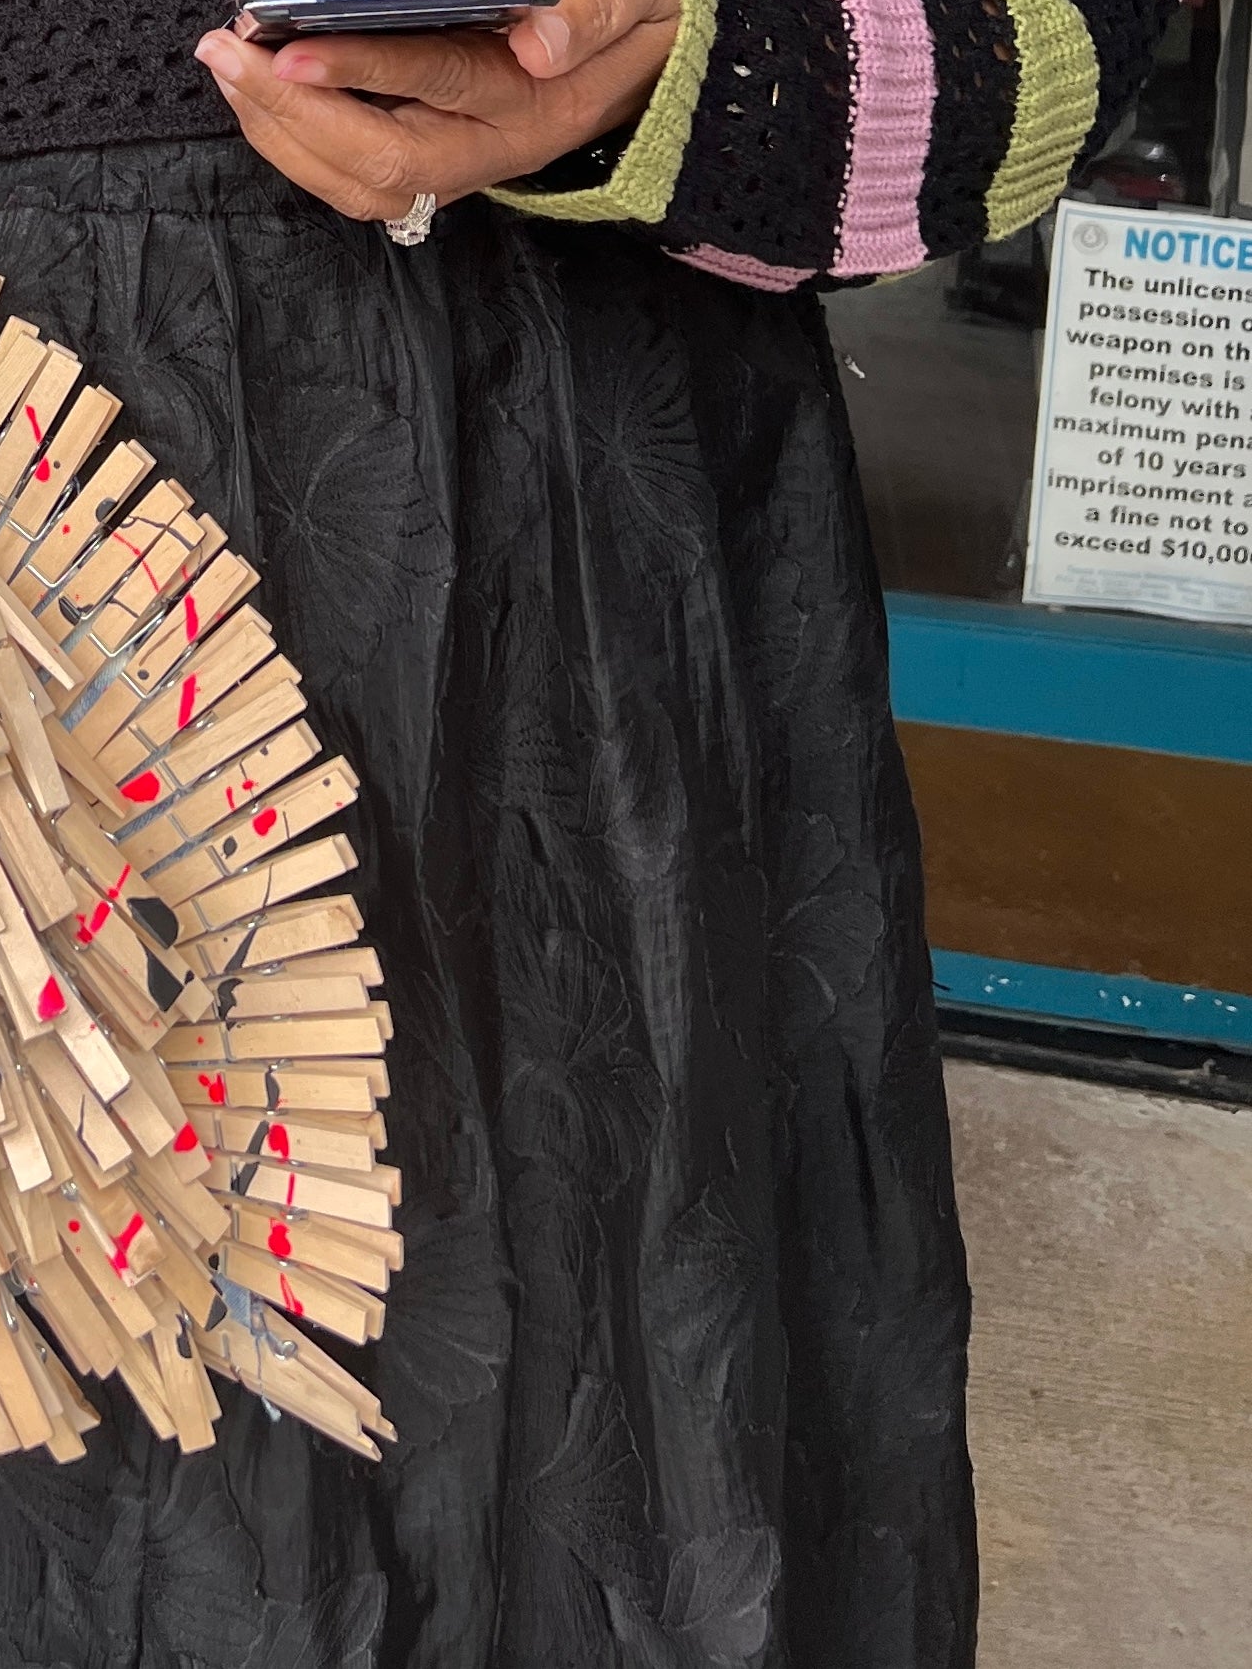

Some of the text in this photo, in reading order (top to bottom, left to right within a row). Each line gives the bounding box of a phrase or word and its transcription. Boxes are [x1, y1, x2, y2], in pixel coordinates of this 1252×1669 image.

[1124, 226, 1252, 272] NOTICE
[1085, 266, 1134, 291] The
[1079, 302, 1231, 331] possession
[1066, 328, 1172, 355] weapon
[1182, 341, 1214, 359] on
[1089, 361, 1246, 391] premises is
[1089, 385, 1173, 417] felony
[1181, 397, 1240, 420] with
[1053, 415, 1186, 444] maximum
[1098, 446, 1247, 478] of 10 years
[1048, 467, 1234, 506] imprisonment
[1084, 505, 1249, 536] a fine not to
[1054, 531, 1252, 565] exceed $10,00
